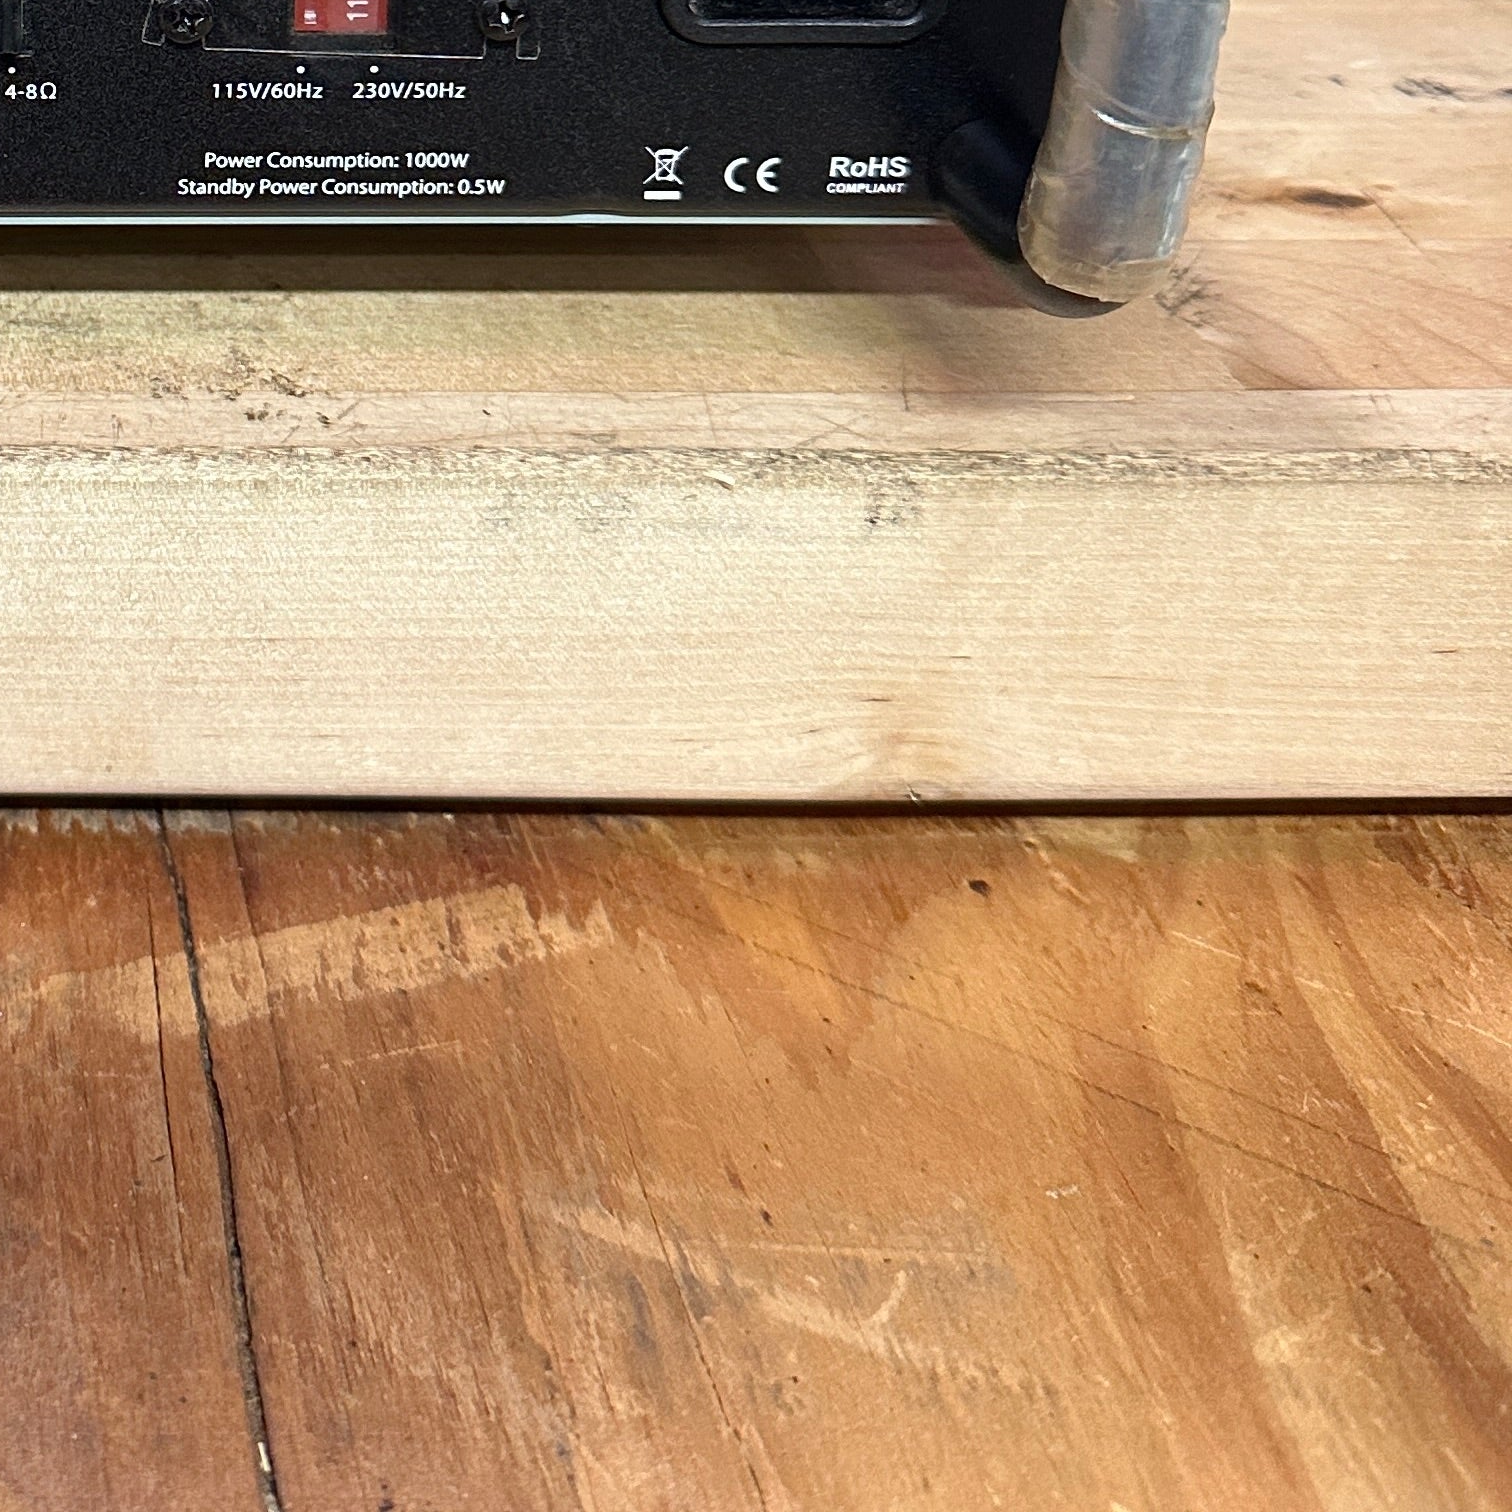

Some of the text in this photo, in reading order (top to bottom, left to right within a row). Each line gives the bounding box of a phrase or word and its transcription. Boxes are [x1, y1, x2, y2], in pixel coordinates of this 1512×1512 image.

[212, 81, 467, 100] 115V/60Hz 230V/50Hz
[204, 151, 470, 172] Power Consumption: 1000W
[828, 156, 909, 178] RoHS
[723, 157, 782, 193] CE
[177, 177, 506, 199] Standby Power Consumption: 0.5W
[826, 182, 905, 194] COMPLIANT
